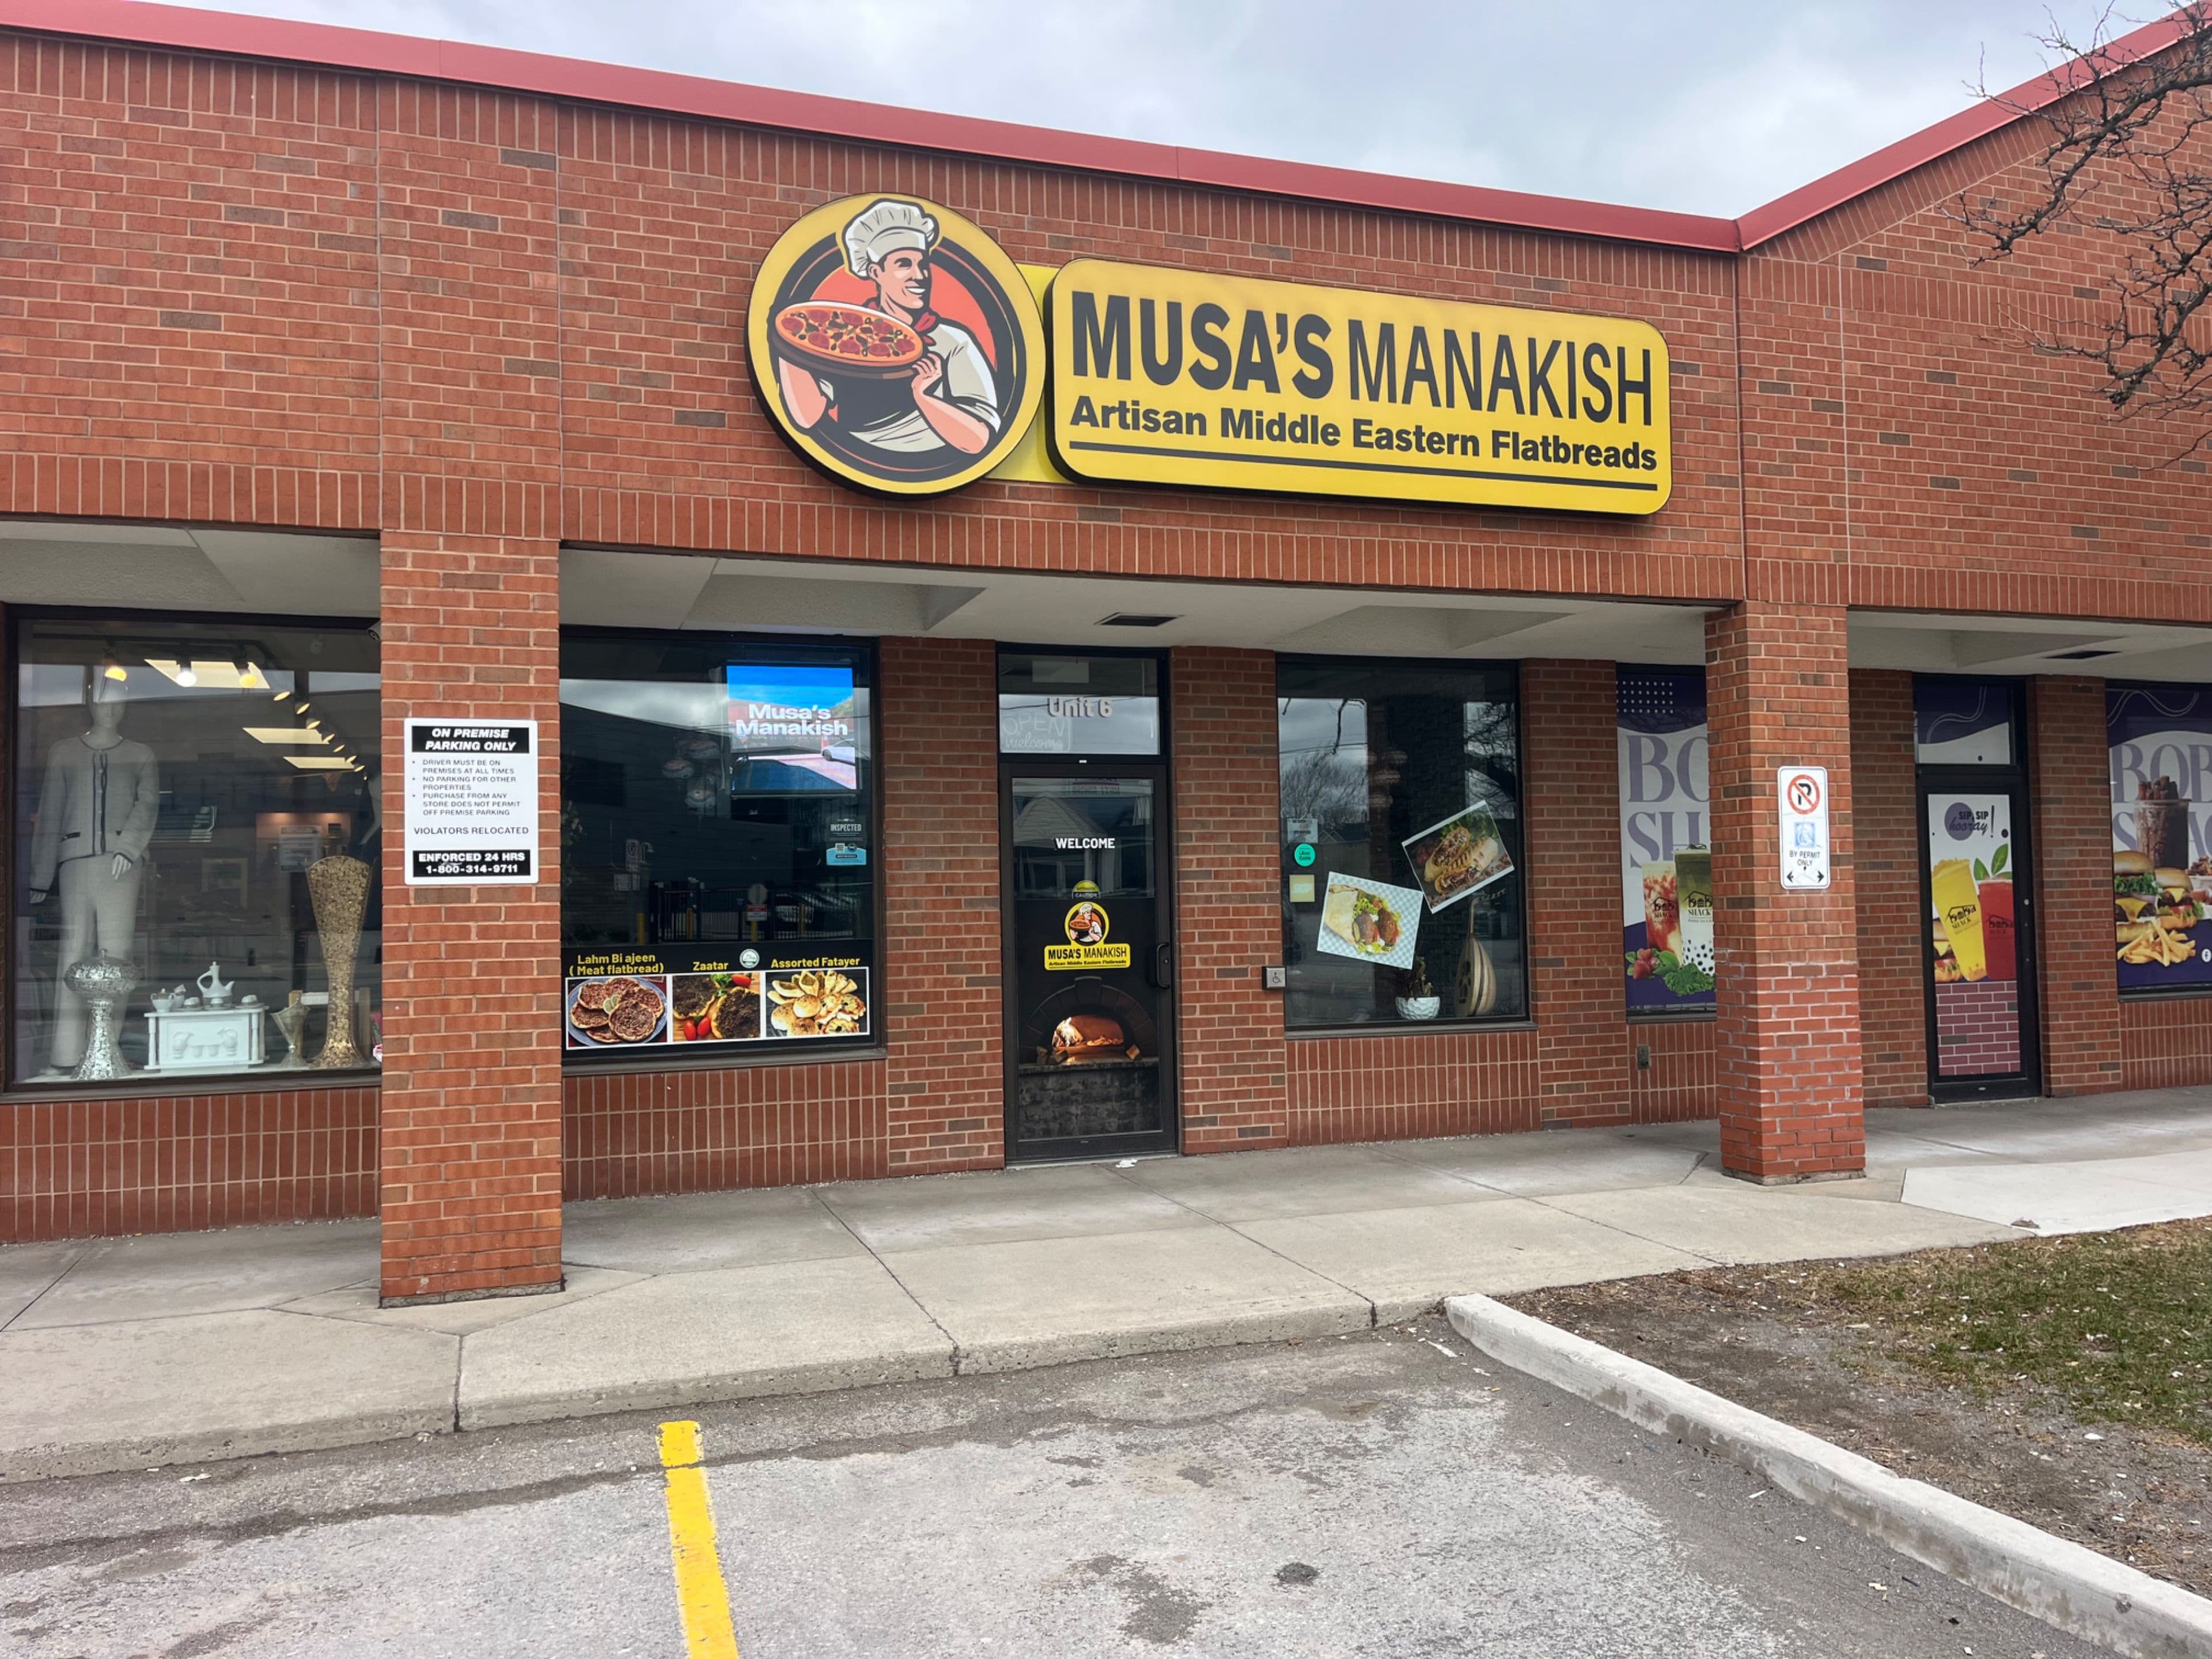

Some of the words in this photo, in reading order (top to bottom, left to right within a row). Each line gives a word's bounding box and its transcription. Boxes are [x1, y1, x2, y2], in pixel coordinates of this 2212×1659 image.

[1071, 291, 1333, 399] MUSA'S
[1349, 319, 1652, 426] MANAKISH
[1070, 396, 1207, 437] Artisan
[1221, 408, 1341, 446] Middle
[1353, 419, 1480, 457] Eastern
[1491, 431, 1658, 471] Flatbreads
[749, 704, 831, 719] Musa's
[1047, 698, 1093, 717] Unit
[1099, 699, 1113, 718] 6
[736, 719, 848, 735] Manakish
[1004, 711, 1065, 737] OPEN
[432, 728, 450, 737] ON
[453, 728, 510, 738] PREMISE
[425, 741, 480, 751] PARKING
[484, 741, 516, 751] ONLY
[1976, 811, 1988, 820] SIP
[1056, 838, 1115, 849] WELCOME
[419, 853, 481, 862] ENFORCED
[484, 853, 498, 861] 24
[502, 853, 525, 861] HRS
[426, 865, 518, 874] 1-800-314-9711
[578, 955, 609, 964] Lahm
[612, 953, 622, 963] Bi
[625, 953, 656, 965] ajeen
[1048, 949, 1081, 960] MUSA'S
[1084, 946, 1127, 958] MANAKISH
[693, 961, 728, 971] Zaatar
[771, 957, 819, 968] Assorted
[821, 957, 860, 968] Fatayer
[578, 965, 604, 975] Meat
[607, 963, 664, 974] flatbread)
